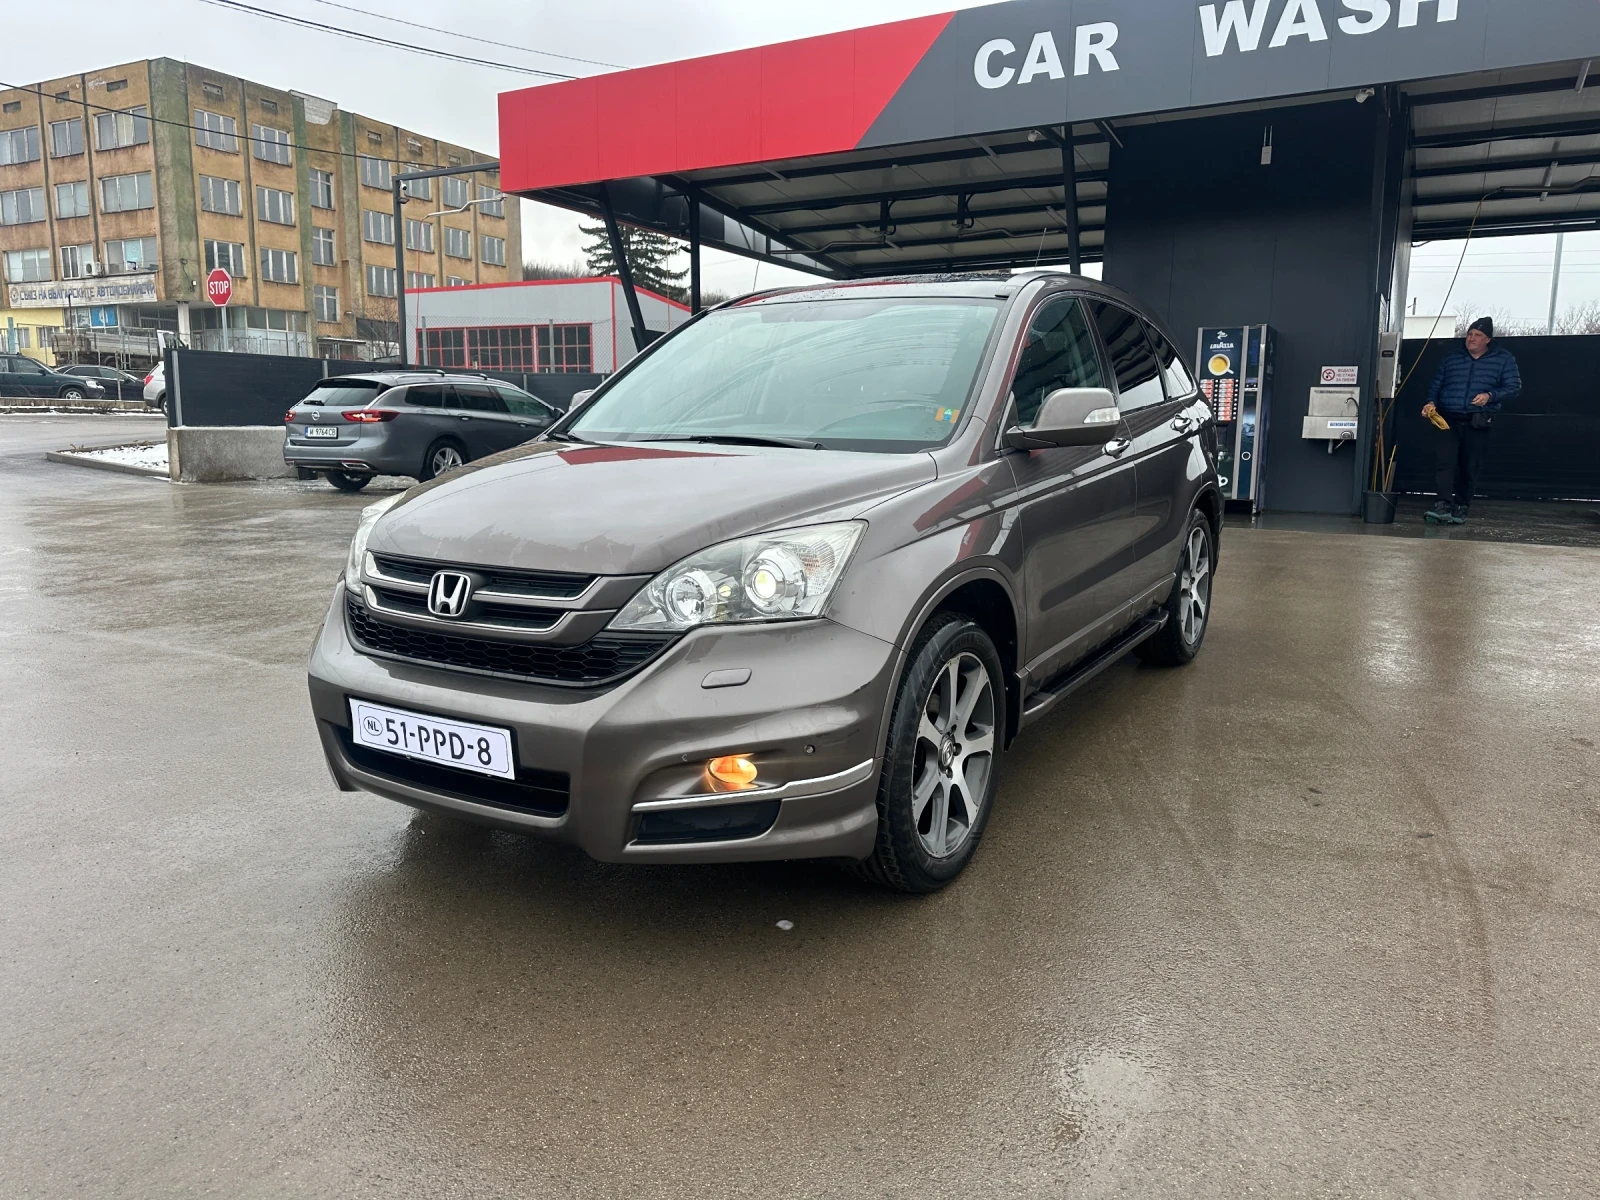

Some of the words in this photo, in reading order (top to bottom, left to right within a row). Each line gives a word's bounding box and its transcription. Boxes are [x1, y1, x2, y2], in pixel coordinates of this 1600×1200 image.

[974, 21, 1120, 89] CAR
[38, 289, 47, 300] НА
[209, 281, 229, 295] STOP
[1209, 341, 1235, 350] LAVAZZA
[367, 720, 380, 732] NL
[385, 717, 492, 766] 51-PPD-8
